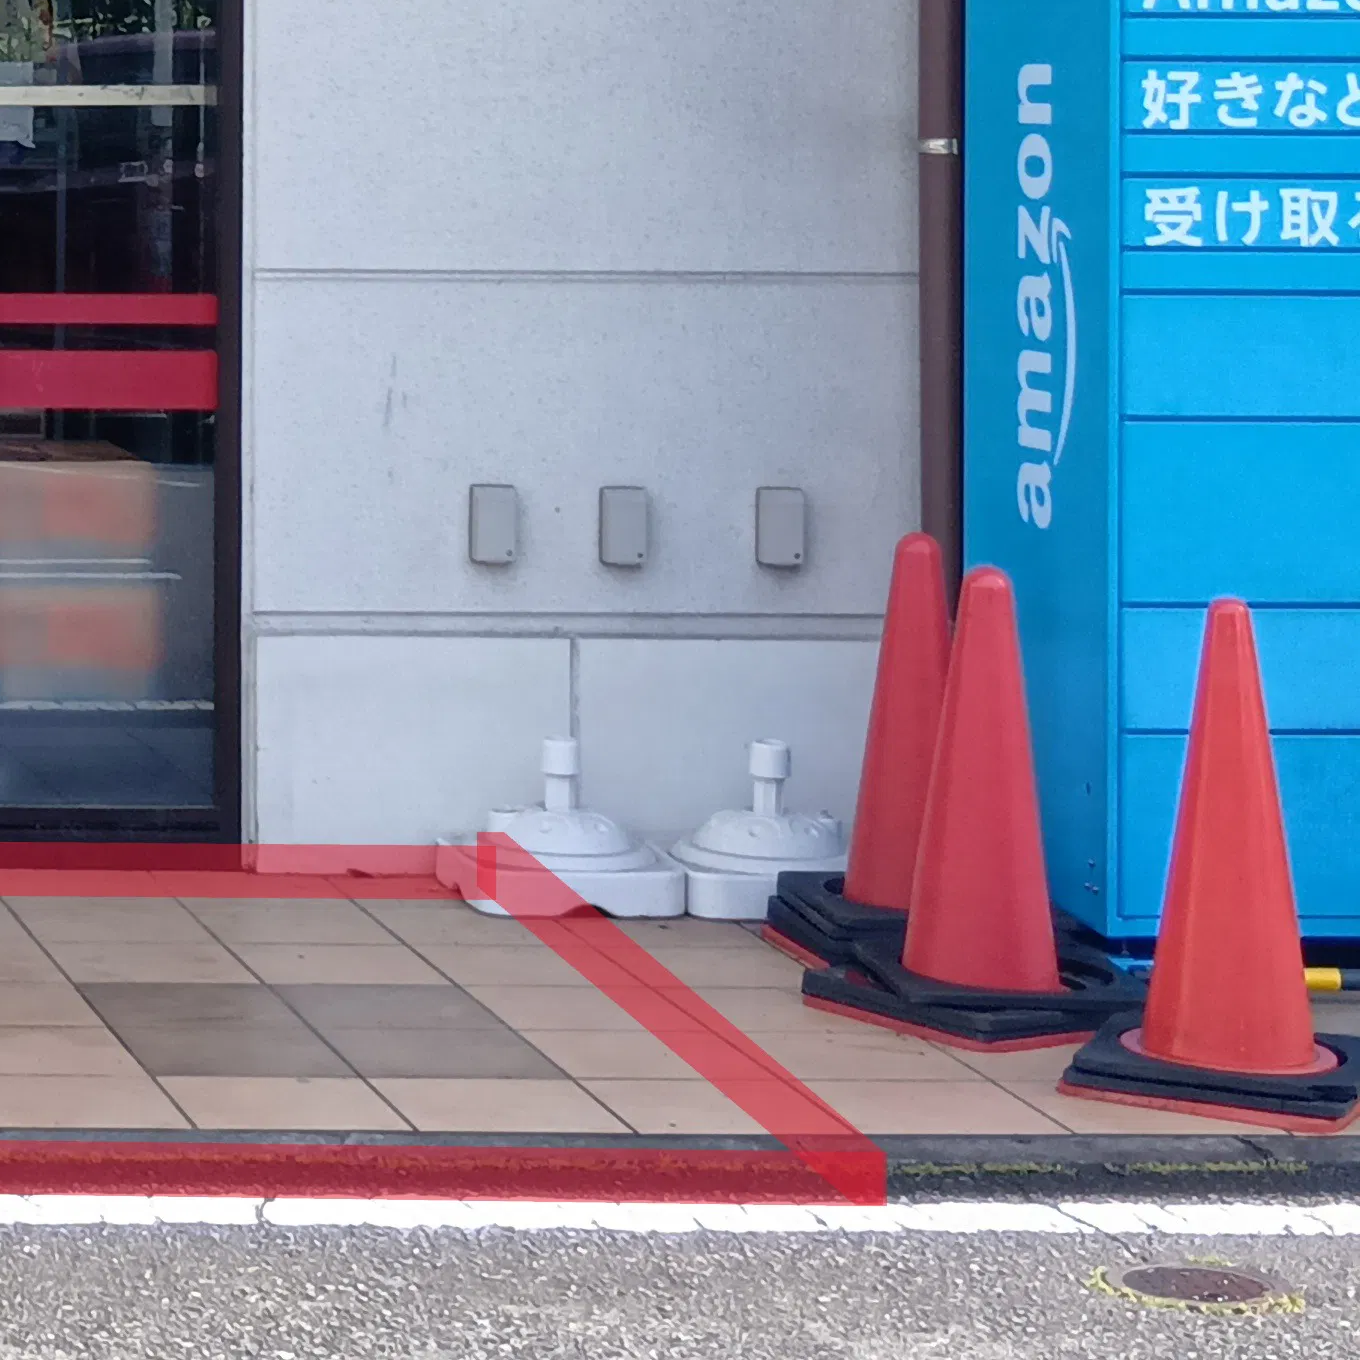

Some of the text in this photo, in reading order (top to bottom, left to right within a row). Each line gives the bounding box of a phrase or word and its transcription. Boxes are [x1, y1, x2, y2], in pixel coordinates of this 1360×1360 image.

[1016, 62, 1055, 529] amazon
[1144, 186, 1360, 248] 受け取
